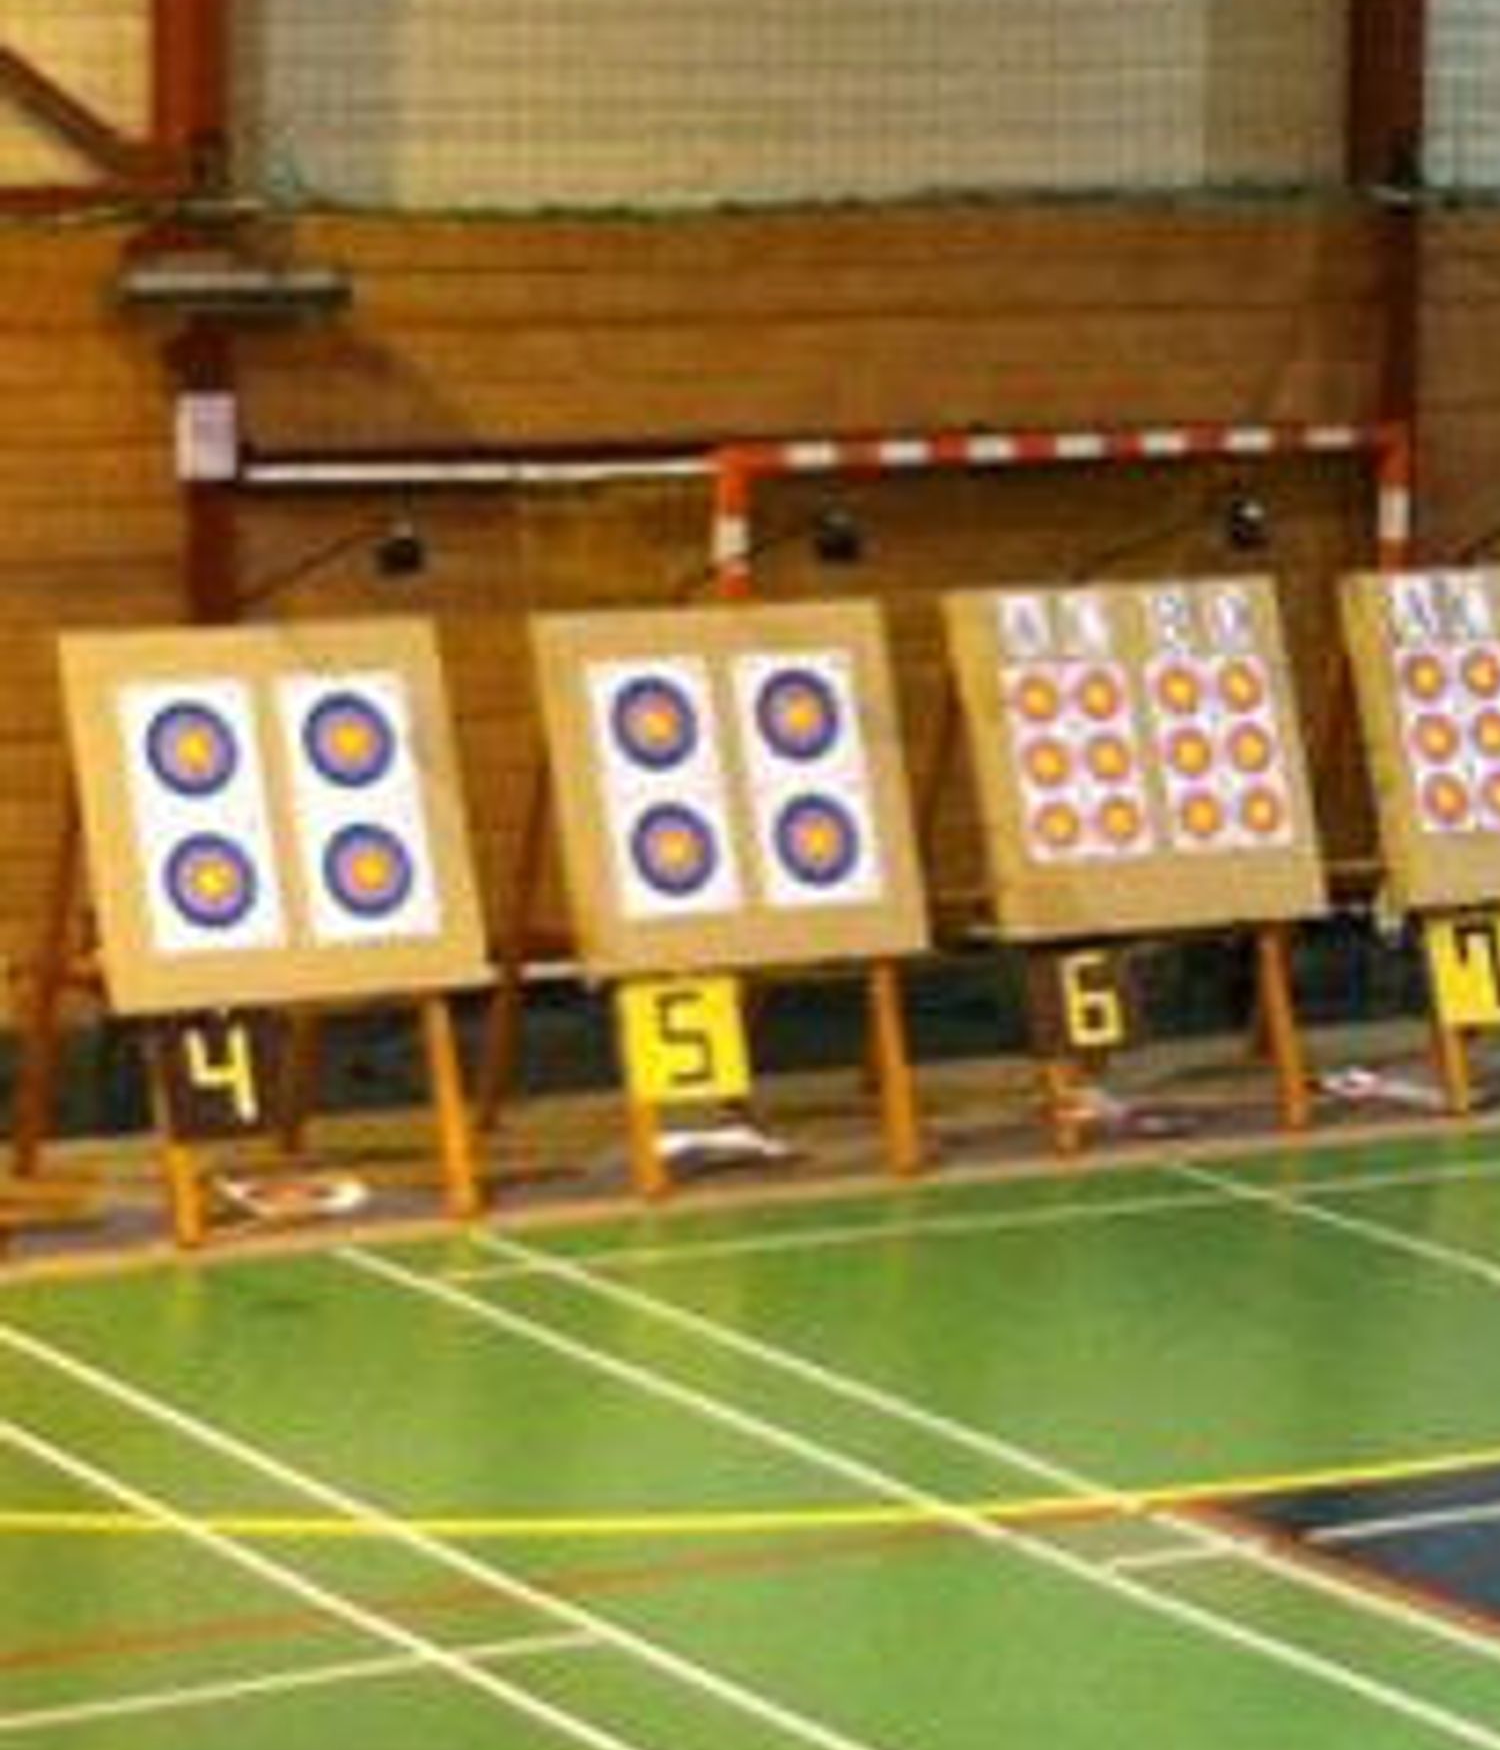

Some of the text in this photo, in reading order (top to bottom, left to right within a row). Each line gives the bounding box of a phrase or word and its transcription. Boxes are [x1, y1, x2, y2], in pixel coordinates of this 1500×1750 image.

[654, 990, 713, 1084] 5
[1062, 952, 1123, 1046] 6
[184, 1025, 258, 1123] 4
